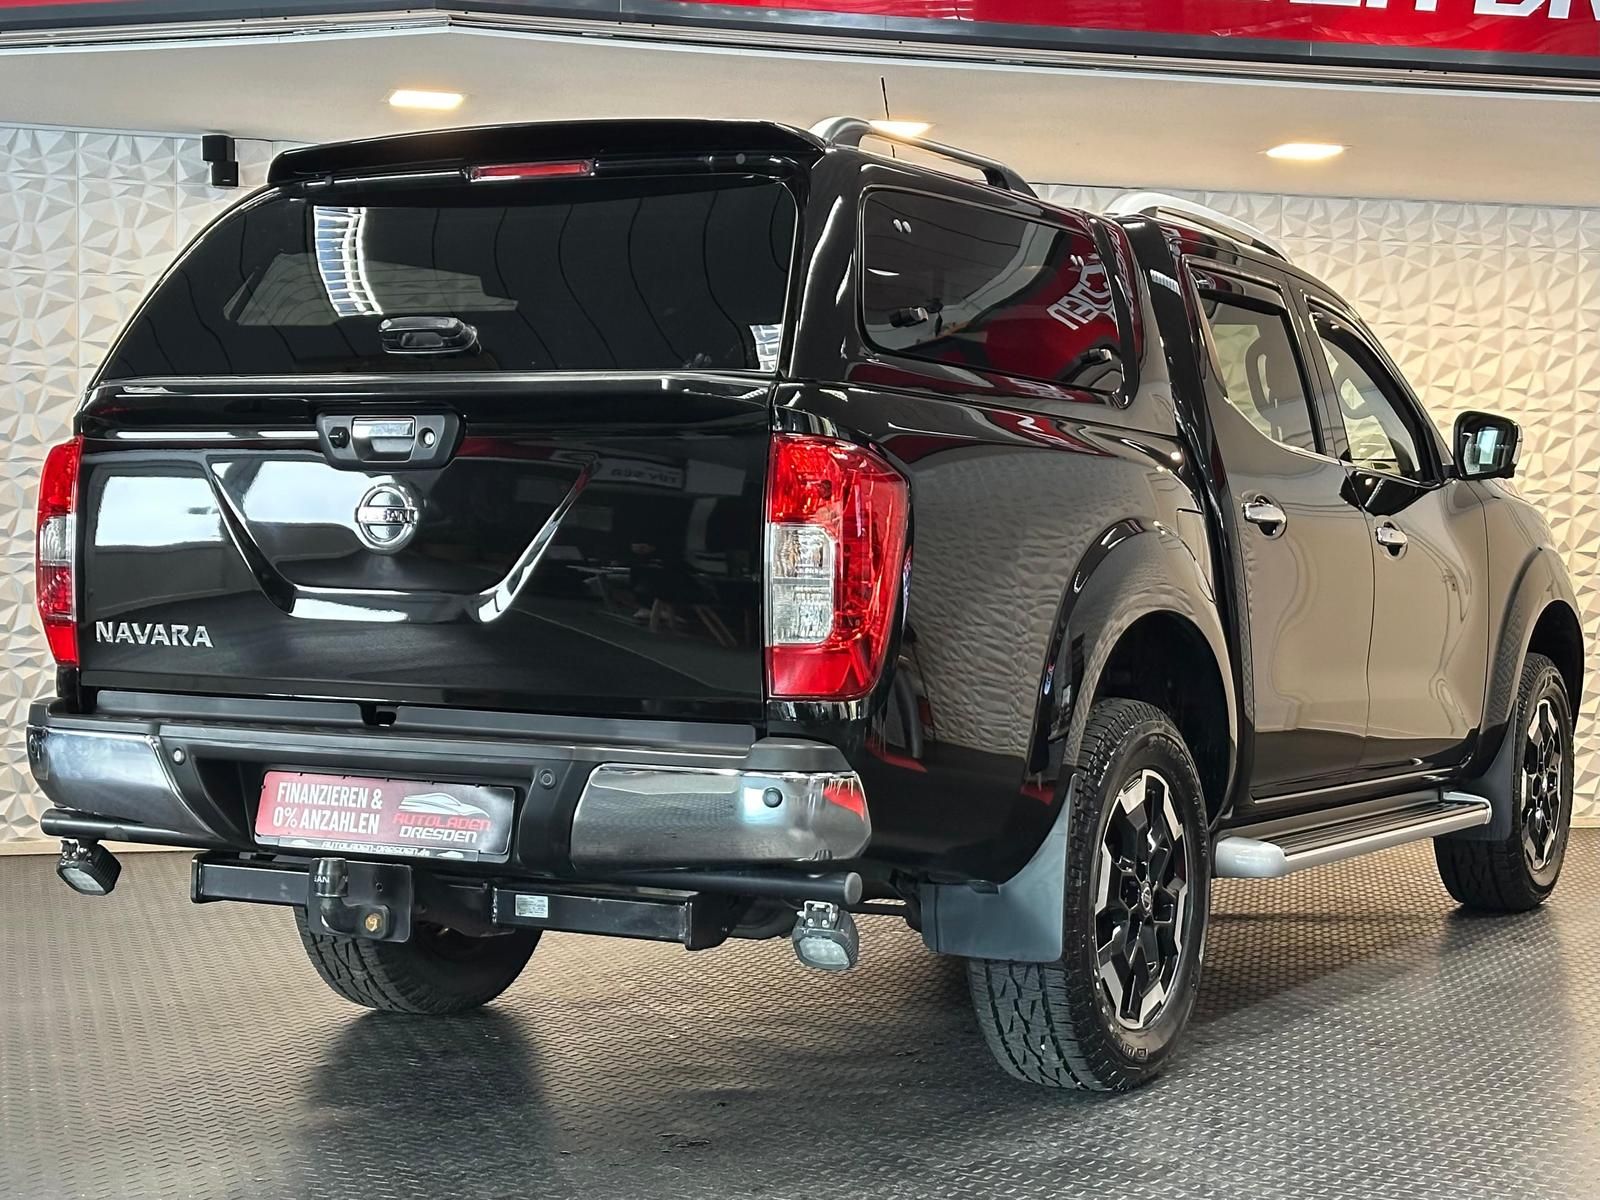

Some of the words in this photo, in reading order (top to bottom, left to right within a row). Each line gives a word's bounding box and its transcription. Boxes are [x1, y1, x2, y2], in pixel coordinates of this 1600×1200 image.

[95, 621, 214, 648] NAVARA
[277, 782, 369, 808] FINANZIEREN
[371, 788, 383, 810] &
[272, 806, 298, 828] 0%
[299, 808, 380, 835] ANZAHLEN
[392, 812, 492, 831] AUTOLADEN
[399, 825, 478, 843] DRESDEN
